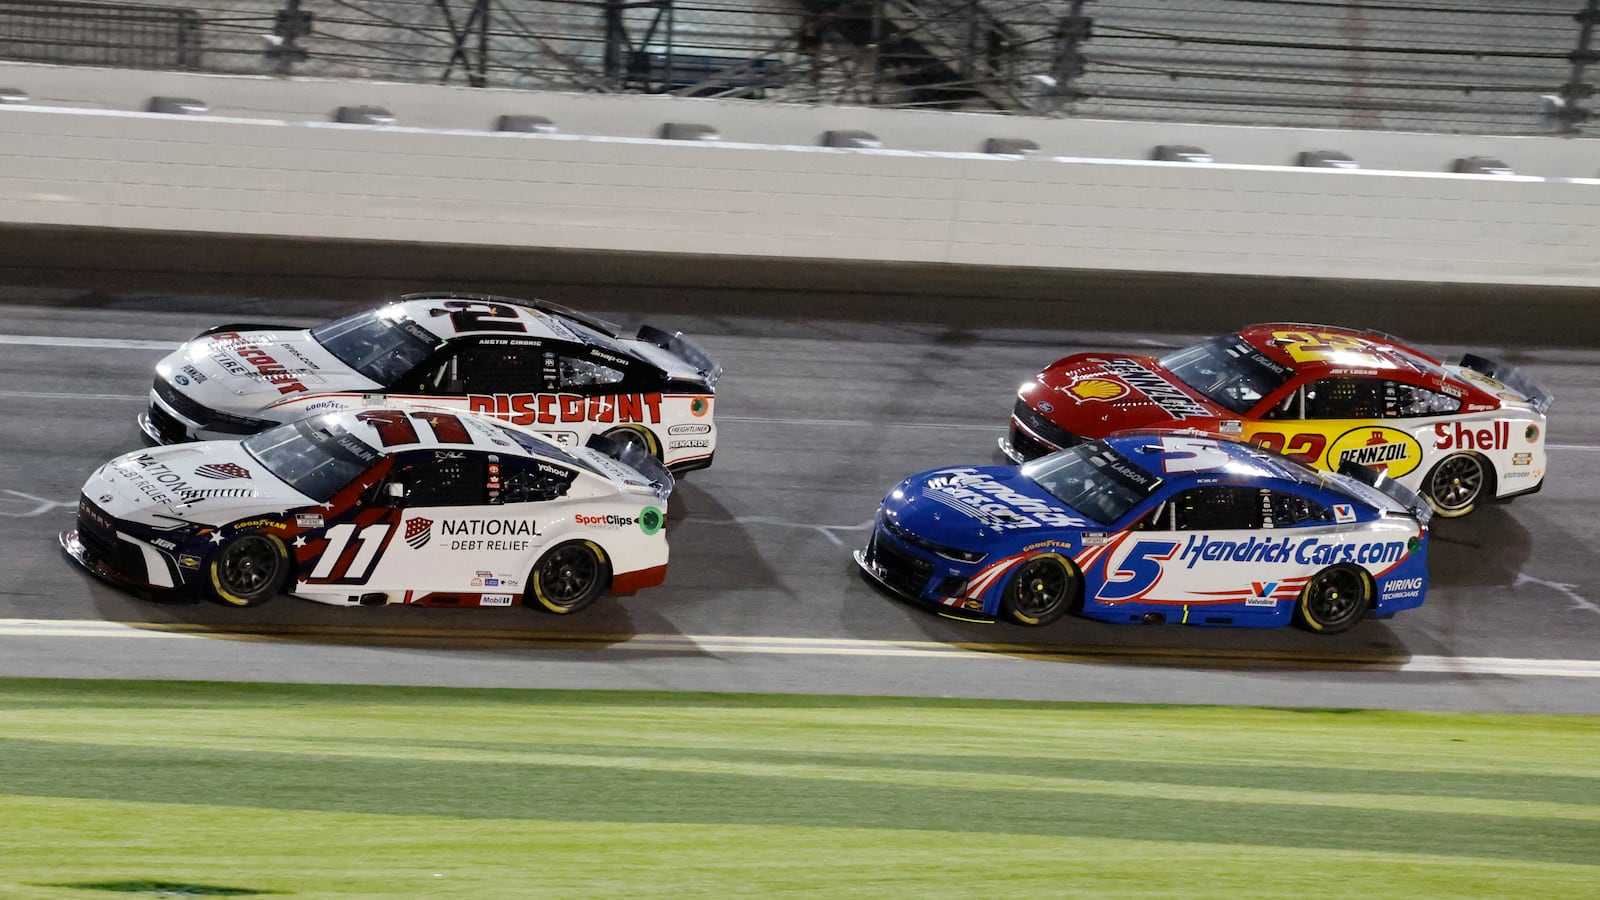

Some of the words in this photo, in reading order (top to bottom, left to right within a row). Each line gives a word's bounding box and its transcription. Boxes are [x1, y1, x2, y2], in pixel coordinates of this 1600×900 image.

[444, 300, 528, 333] 2
[479, 338, 507, 346] AUSTIN
[509, 338, 542, 347] CINDRIC
[590, 349, 629, 366] Snap-on
[1251, 353, 1284, 374] LOGANO
[467, 393, 664, 426] DISCOUNT
[355, 410, 474, 447] 11
[1434, 421, 1510, 450] Shell
[337, 438, 375, 462] HAMLIN
[669, 440, 710, 449] MENARDS
[1161, 436, 1230, 473] 5
[1339, 449, 1409, 467] PENNZOIL
[537, 463, 569, 478] yahoo!
[1111, 461, 1148, 485] LARSON
[233, 519, 287, 530] GOODYEAR
[441, 519, 543, 537] NATIONAL
[575, 514, 633, 527] SportClips
[151, 537, 176, 551] JGR
[310, 523, 391, 579] 11
[451, 541, 484, 551] DEBT
[487, 541, 530, 551] RELIEF
[1022, 540, 1072, 552] GOODYEAR
[1094, 540, 1180, 601] 5
[1384, 578, 1422, 592] HIRING
[483, 596, 503, 604] Mobil
[1382, 591, 1419, 601] TECHNICIANS
